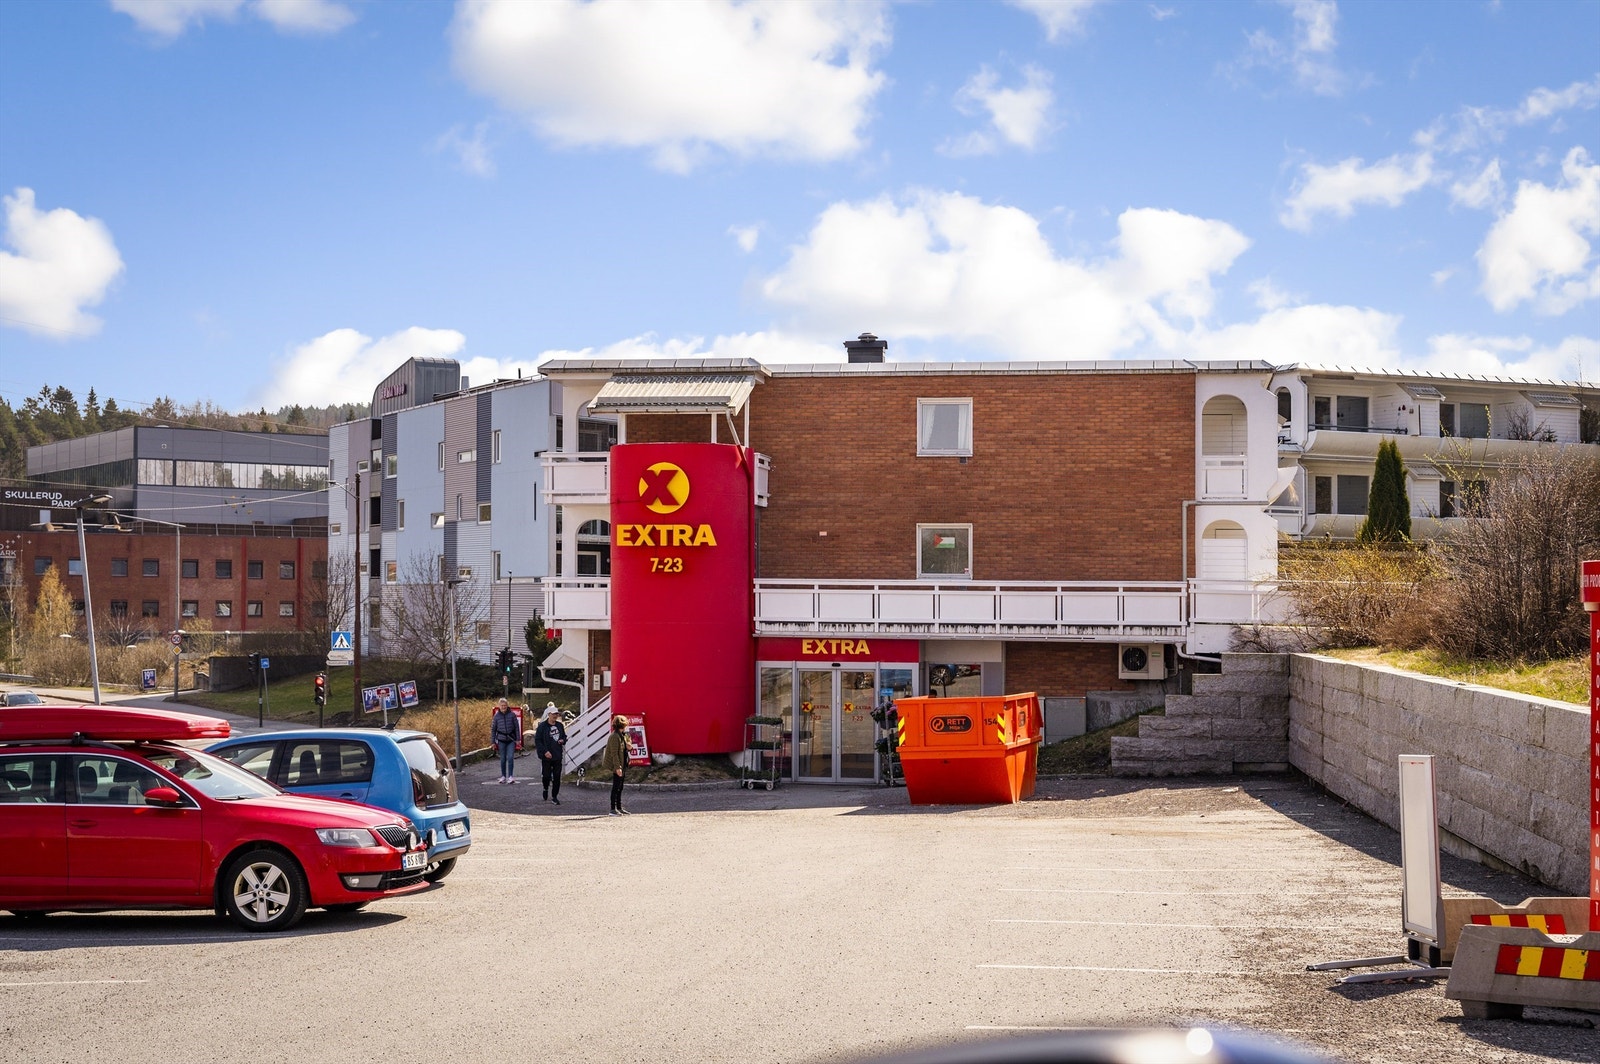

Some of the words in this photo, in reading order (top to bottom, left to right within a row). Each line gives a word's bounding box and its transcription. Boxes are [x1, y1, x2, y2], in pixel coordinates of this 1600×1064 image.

[5, 490, 63, 500] SKULLERUD
[51, 500, 77, 508] PARK
[616, 524, 718, 547] EXTRA
[650, 557, 684, 573] 7-23
[802, 639, 871, 655] EXTRA
[946, 718, 966, 726] RETT
[984, 718, 998, 726] 154
[637, 748, 647, 756] 75
